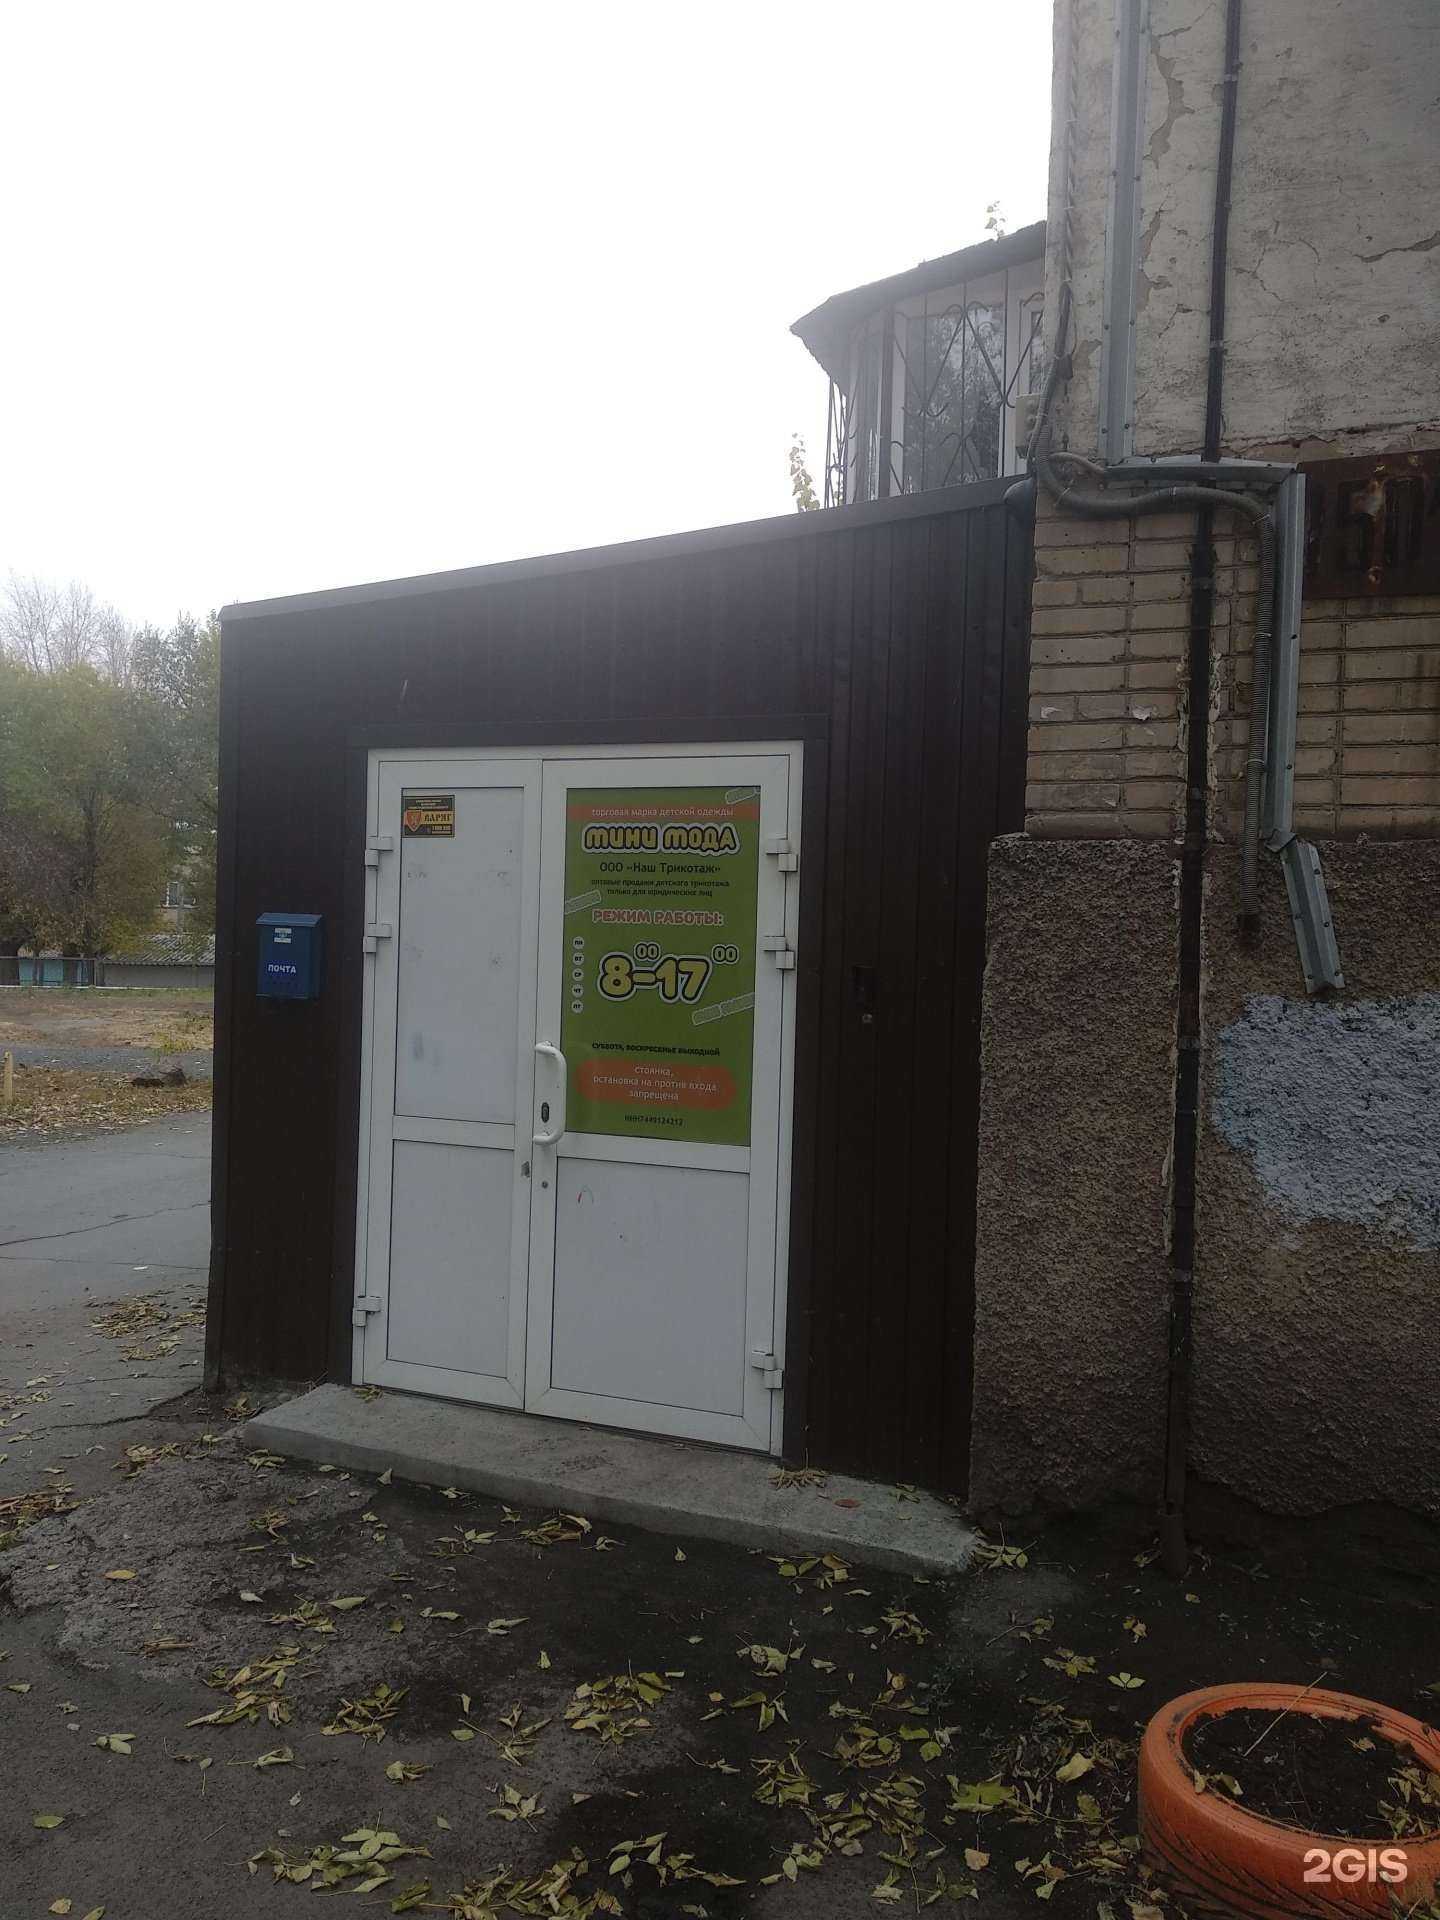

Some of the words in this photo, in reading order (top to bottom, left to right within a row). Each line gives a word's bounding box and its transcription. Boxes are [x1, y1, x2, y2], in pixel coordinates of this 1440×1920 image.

[631, 808, 658, 818] марка
[659, 807, 695, 817] детской
[697, 808, 734, 817] одежды
[600, 862, 623, 872] ООО
[592, 909, 650, 924] РЕЖИМ
[652, 910, 723, 926] РАБОТЫ:
[267, 964, 297, 974] ПОЧТА
